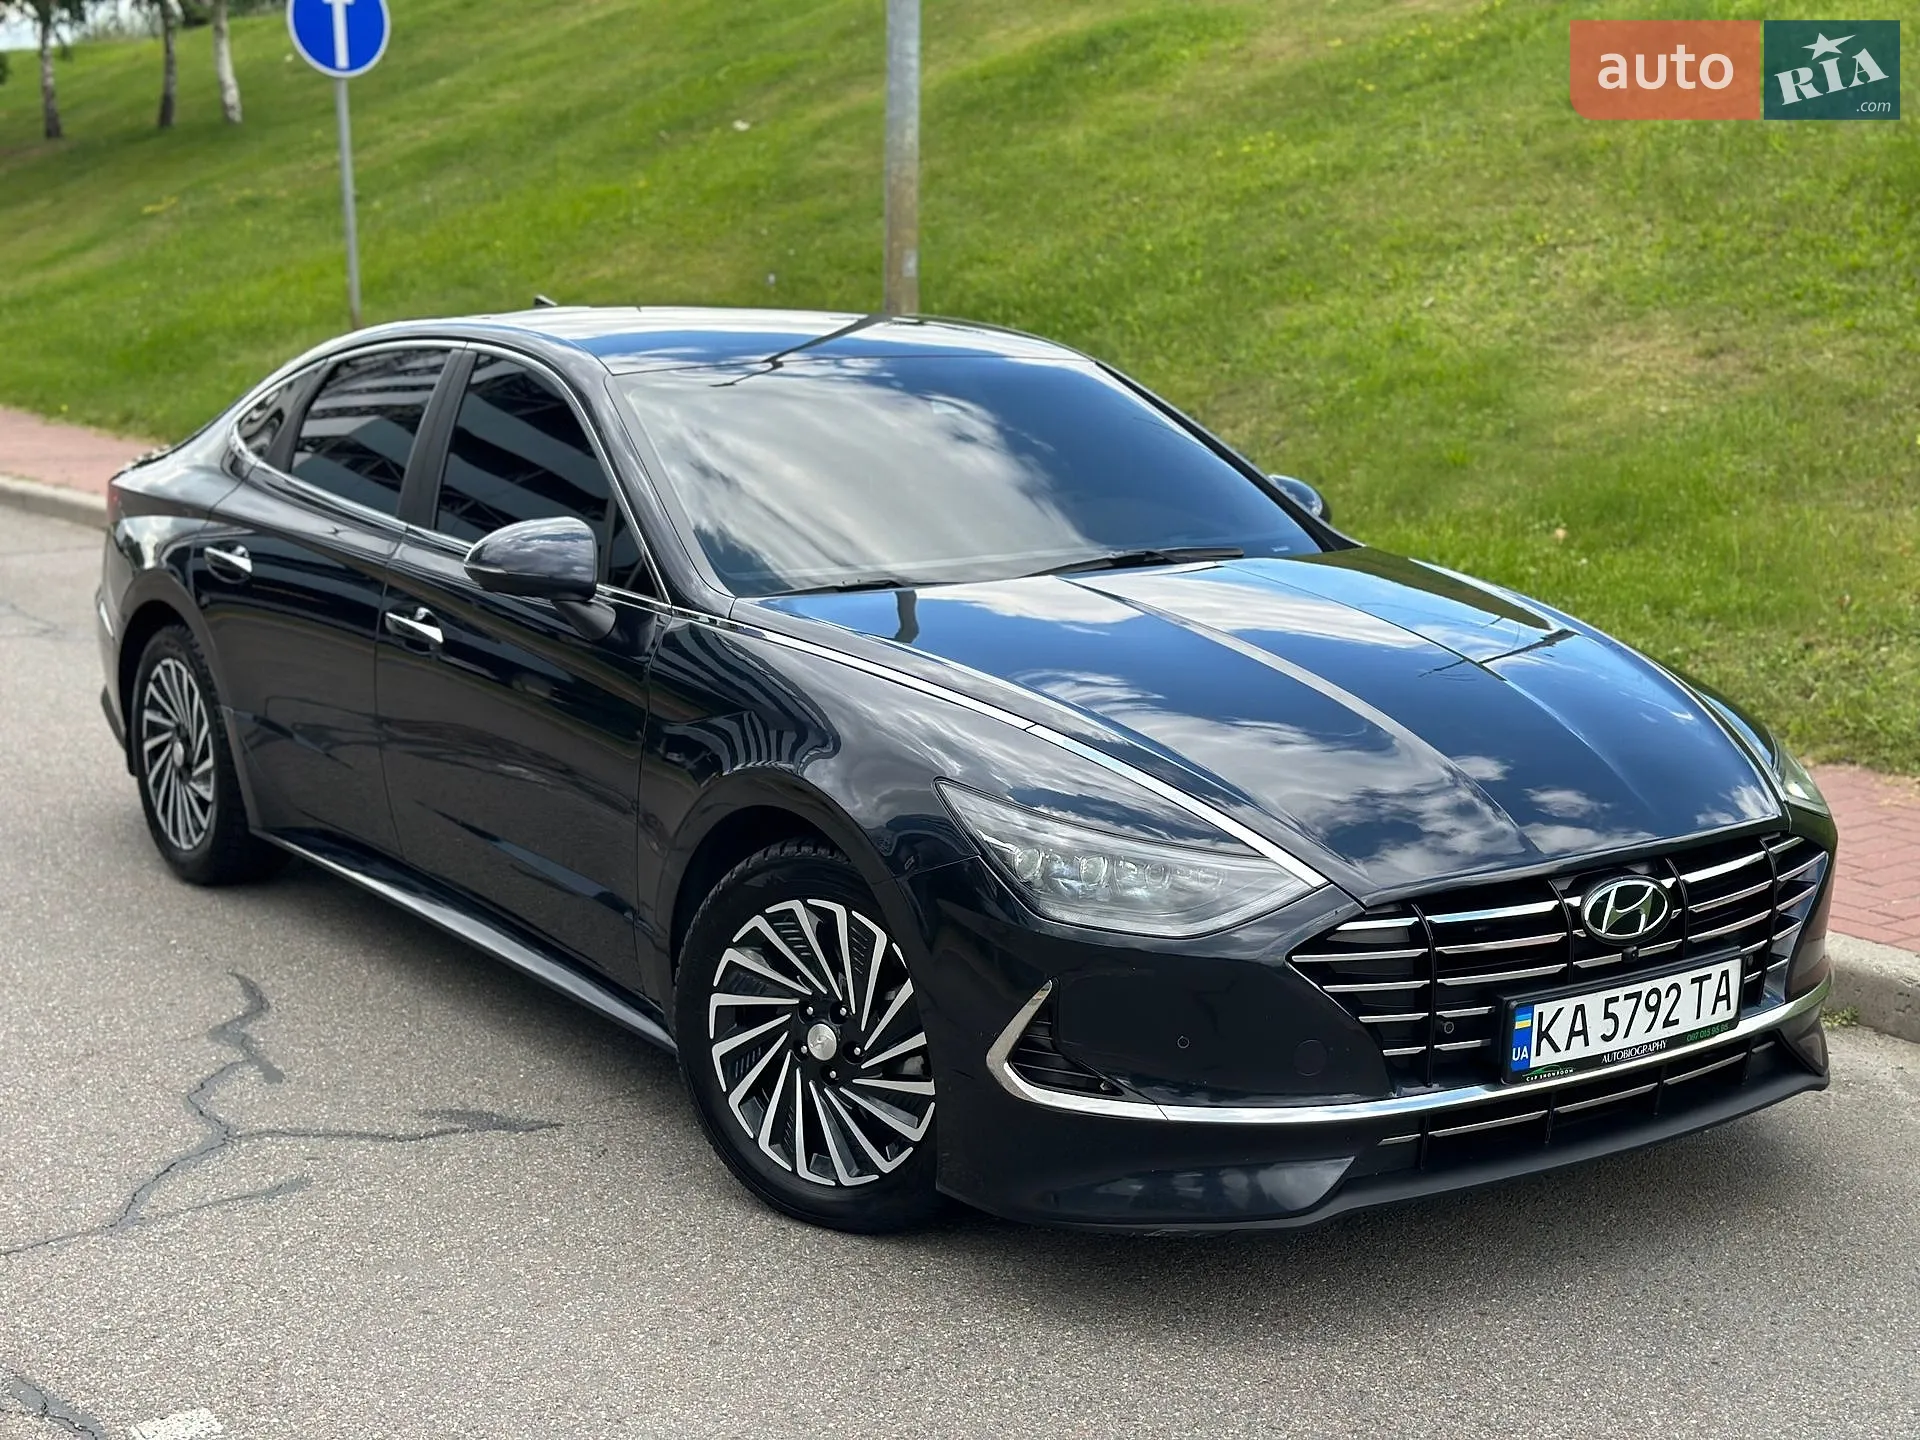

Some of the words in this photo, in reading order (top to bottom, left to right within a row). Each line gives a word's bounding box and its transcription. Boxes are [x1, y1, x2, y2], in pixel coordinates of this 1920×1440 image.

[1536, 1004, 1590, 1057] KA
[1601, 983, 1682, 1042] 5792
[1691, 969, 1731, 1020] TA
[1512, 1046, 1528, 1061] UA
[1602, 1040, 1667, 1063] AUTOBIOGRAPHY
